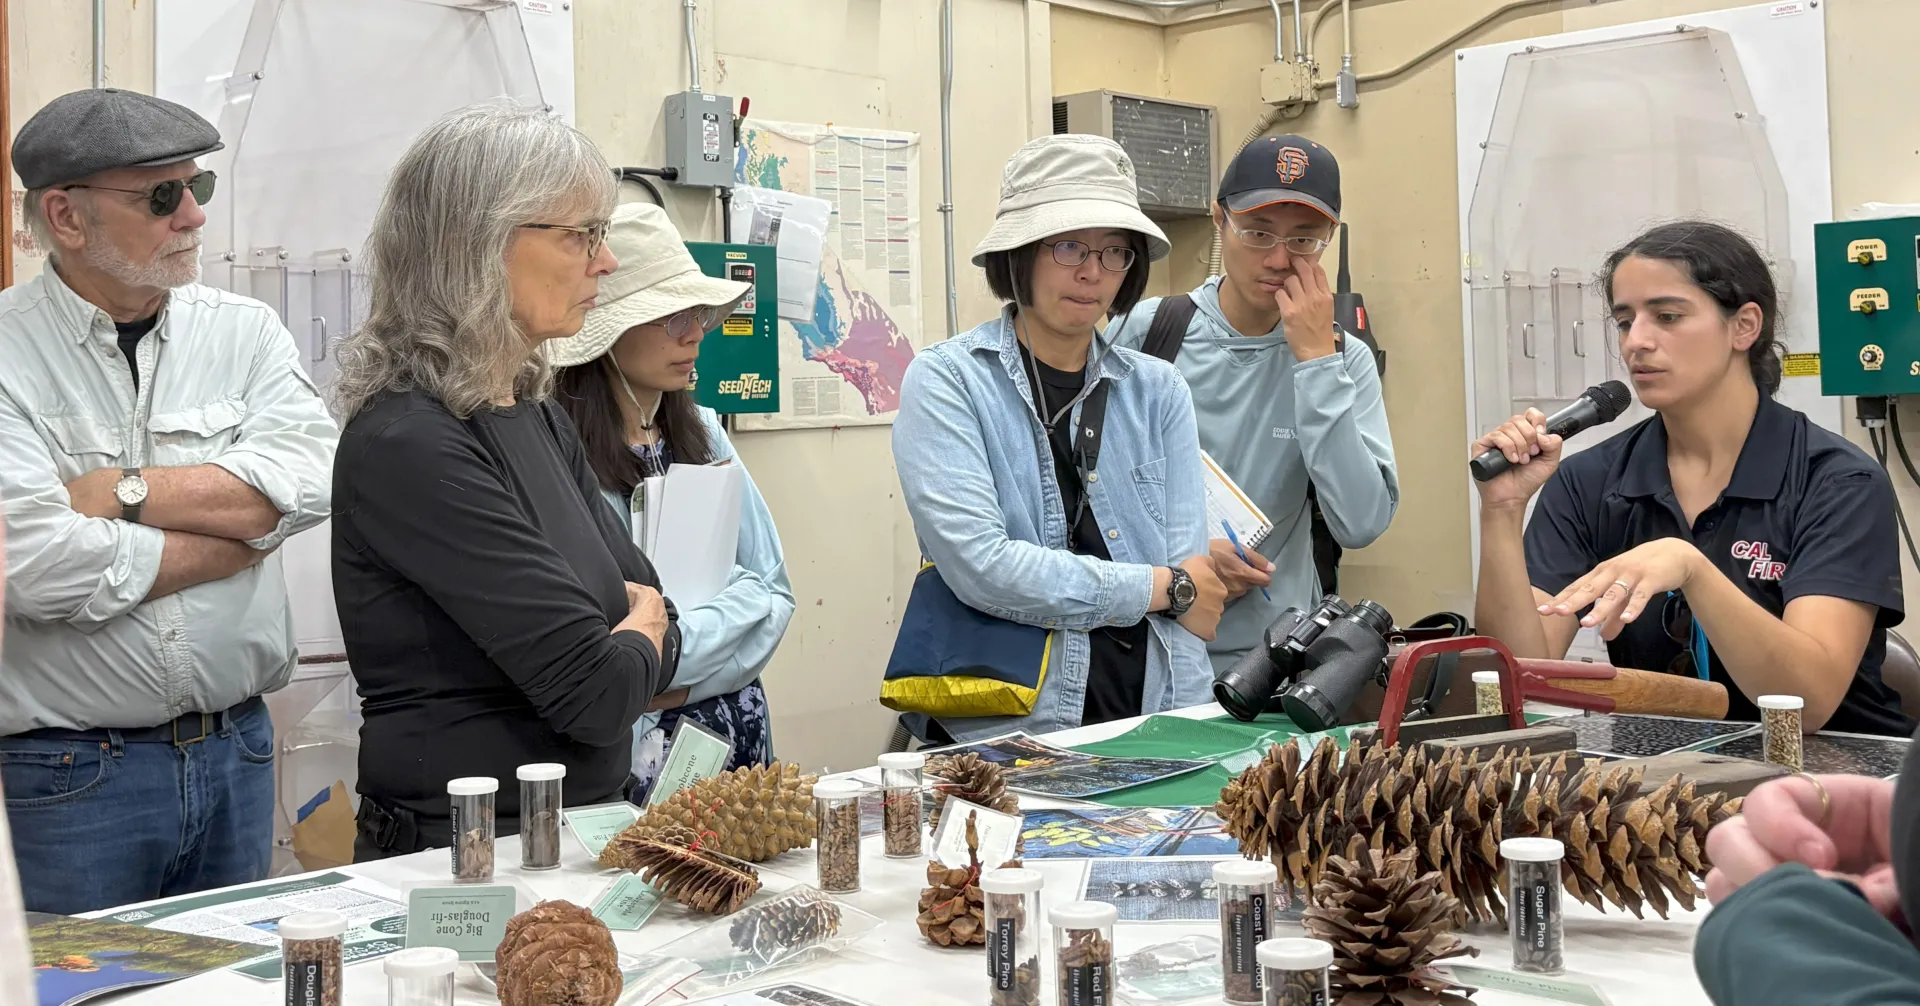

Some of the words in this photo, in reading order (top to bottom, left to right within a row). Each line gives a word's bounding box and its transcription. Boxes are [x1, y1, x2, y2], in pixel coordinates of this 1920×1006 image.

[1276, 146, 1310, 184] SF
[718, 373, 772, 400] SEEDTECH
[1731, 540, 1772, 560] CAL
[1748, 560, 1786, 580] FIR
[676, 754, 697, 794] nobcone
[1254, 896, 1262, 931] Coast
[1536, 886, 1545, 919] Sugar
[430, 910, 490, 924] Douglas-fir
[466, 923, 483, 936] Big
[436, 926, 463, 936] Cone
[1001, 922, 1010, 959] Torrey
[1537, 922, 1546, 948] Pine
[1254, 934, 1263, 988] Rwood
[1002, 962, 1010, 988] Pine
[1093, 966, 1102, 992] Red
